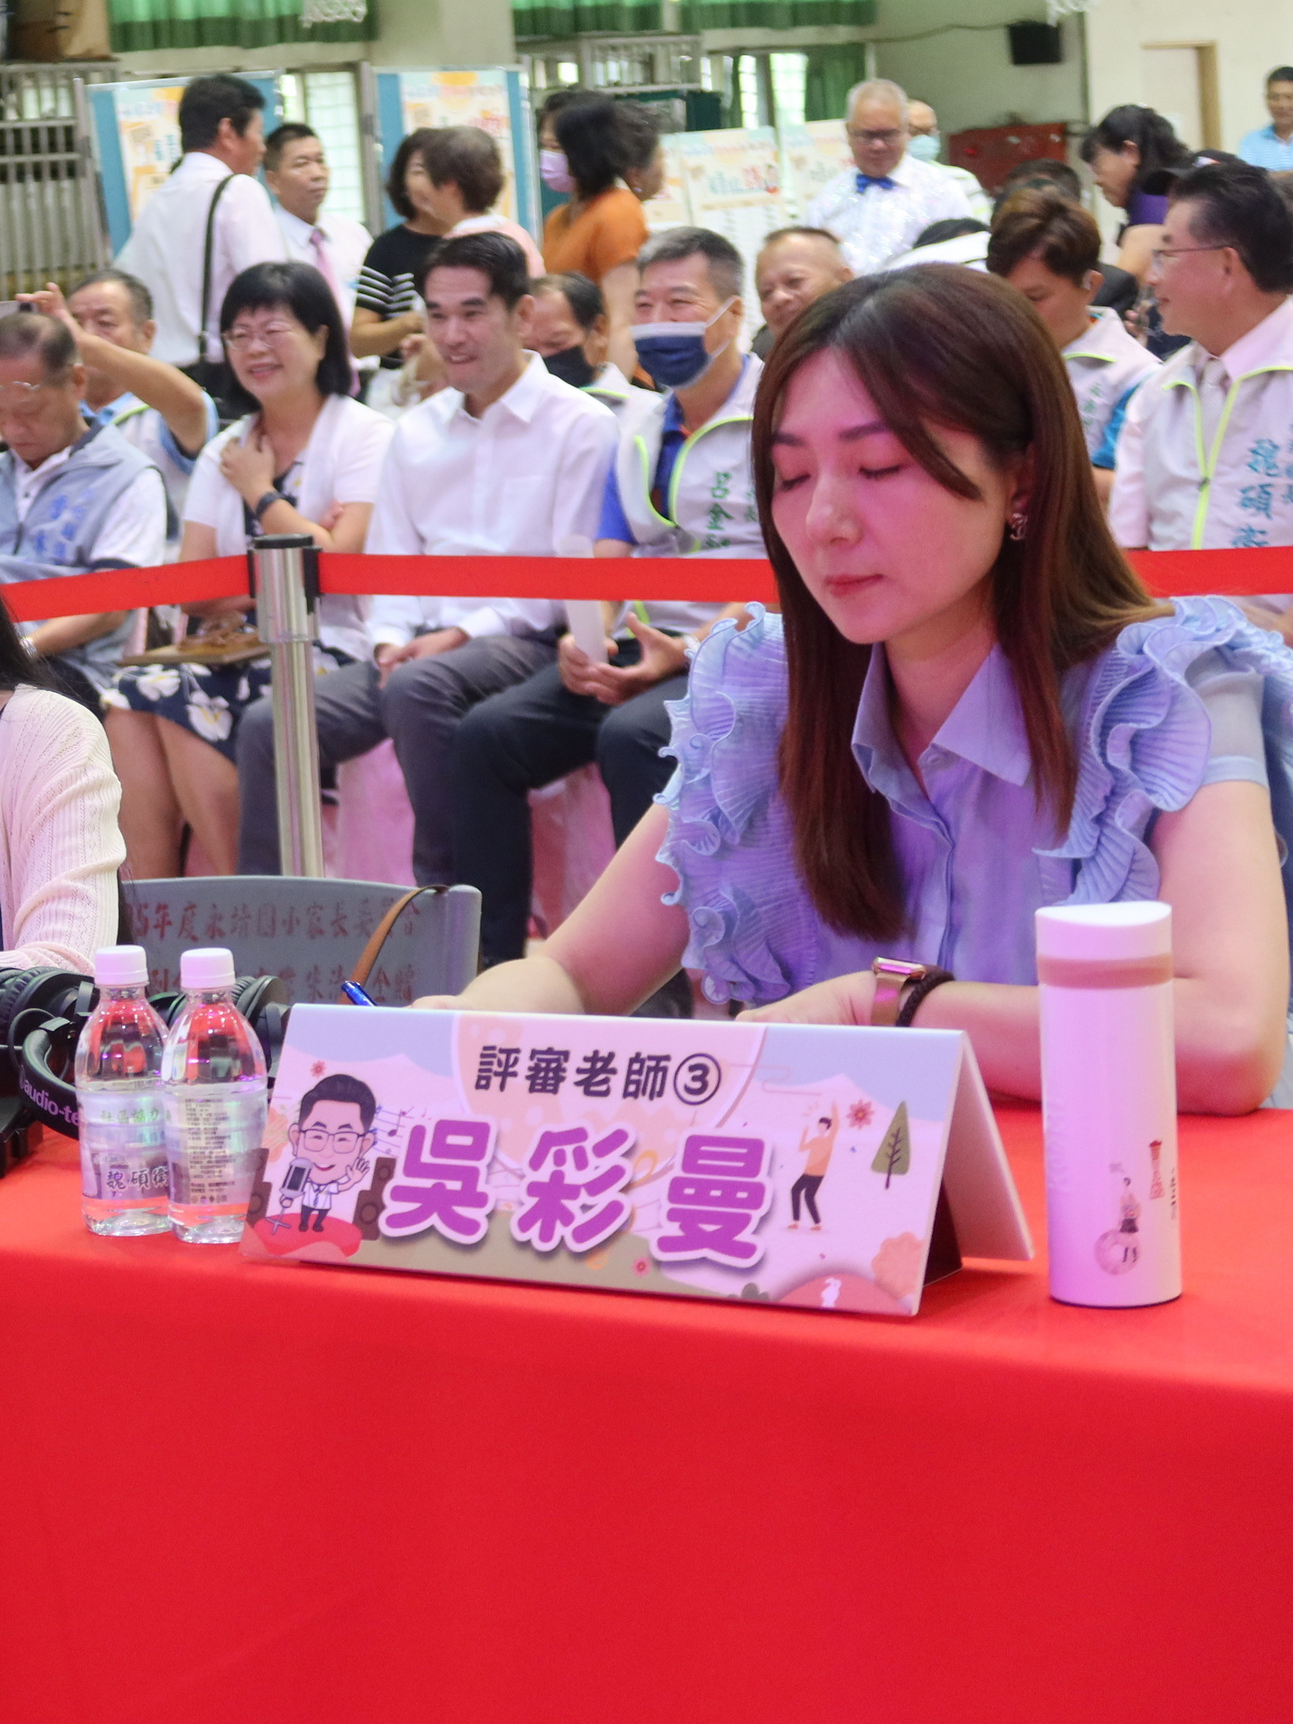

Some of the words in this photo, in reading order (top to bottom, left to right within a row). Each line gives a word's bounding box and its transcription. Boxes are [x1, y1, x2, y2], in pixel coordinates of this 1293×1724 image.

[474, 1045, 722, 1106] 評審老師③
[385, 1118, 767, 1260] 吳彩曼
